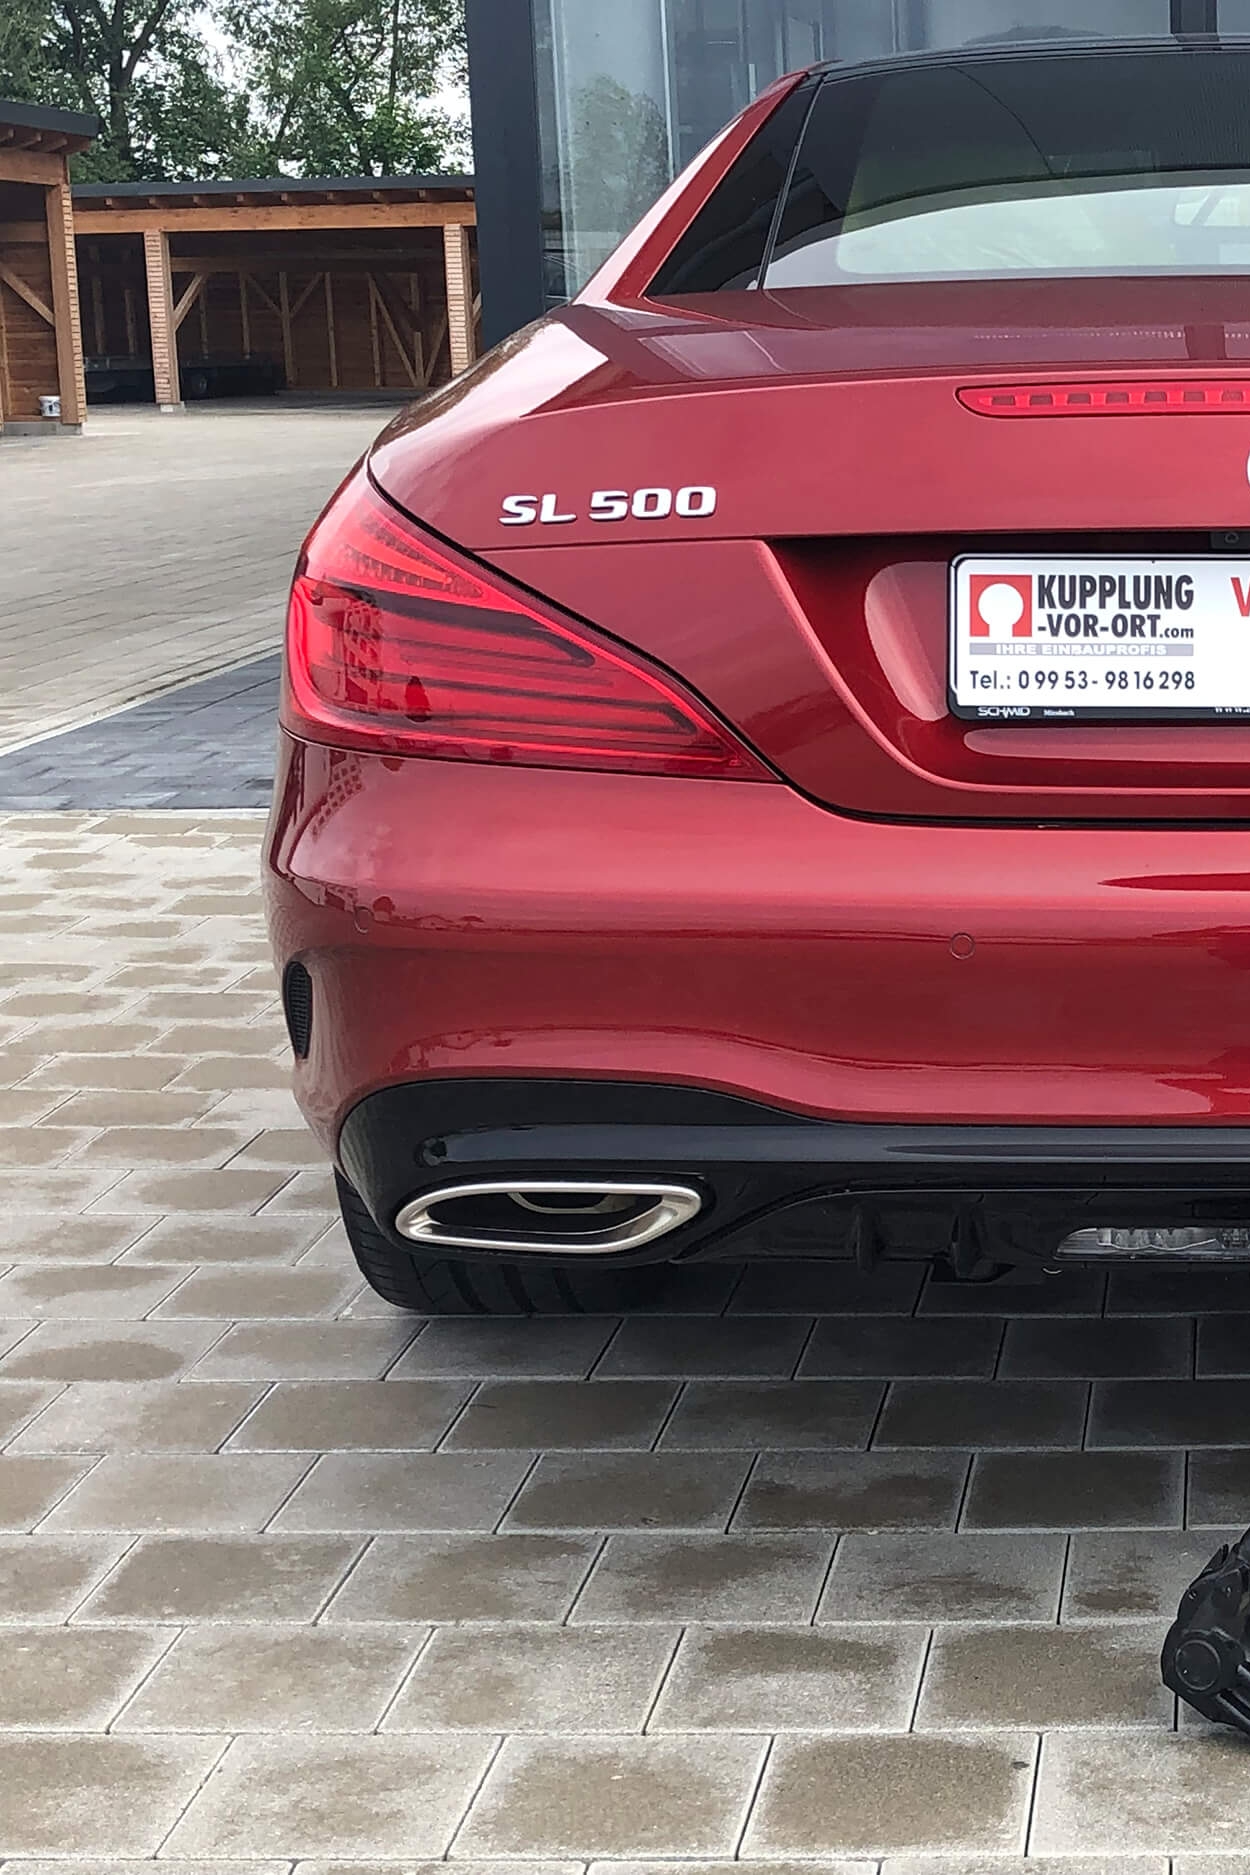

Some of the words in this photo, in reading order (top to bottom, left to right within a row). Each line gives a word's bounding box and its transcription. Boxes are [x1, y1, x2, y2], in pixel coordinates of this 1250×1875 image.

[499, 494, 577, 525] SL
[588, 486, 716, 521] 500
[1038, 574, 1194, 610] KUPPLUNG
[996, 644, 1037, 656] IHRE
[1043, 643, 1167, 656] EINBAUPROFIS
[970, 671, 1010, 690] Tel.:
